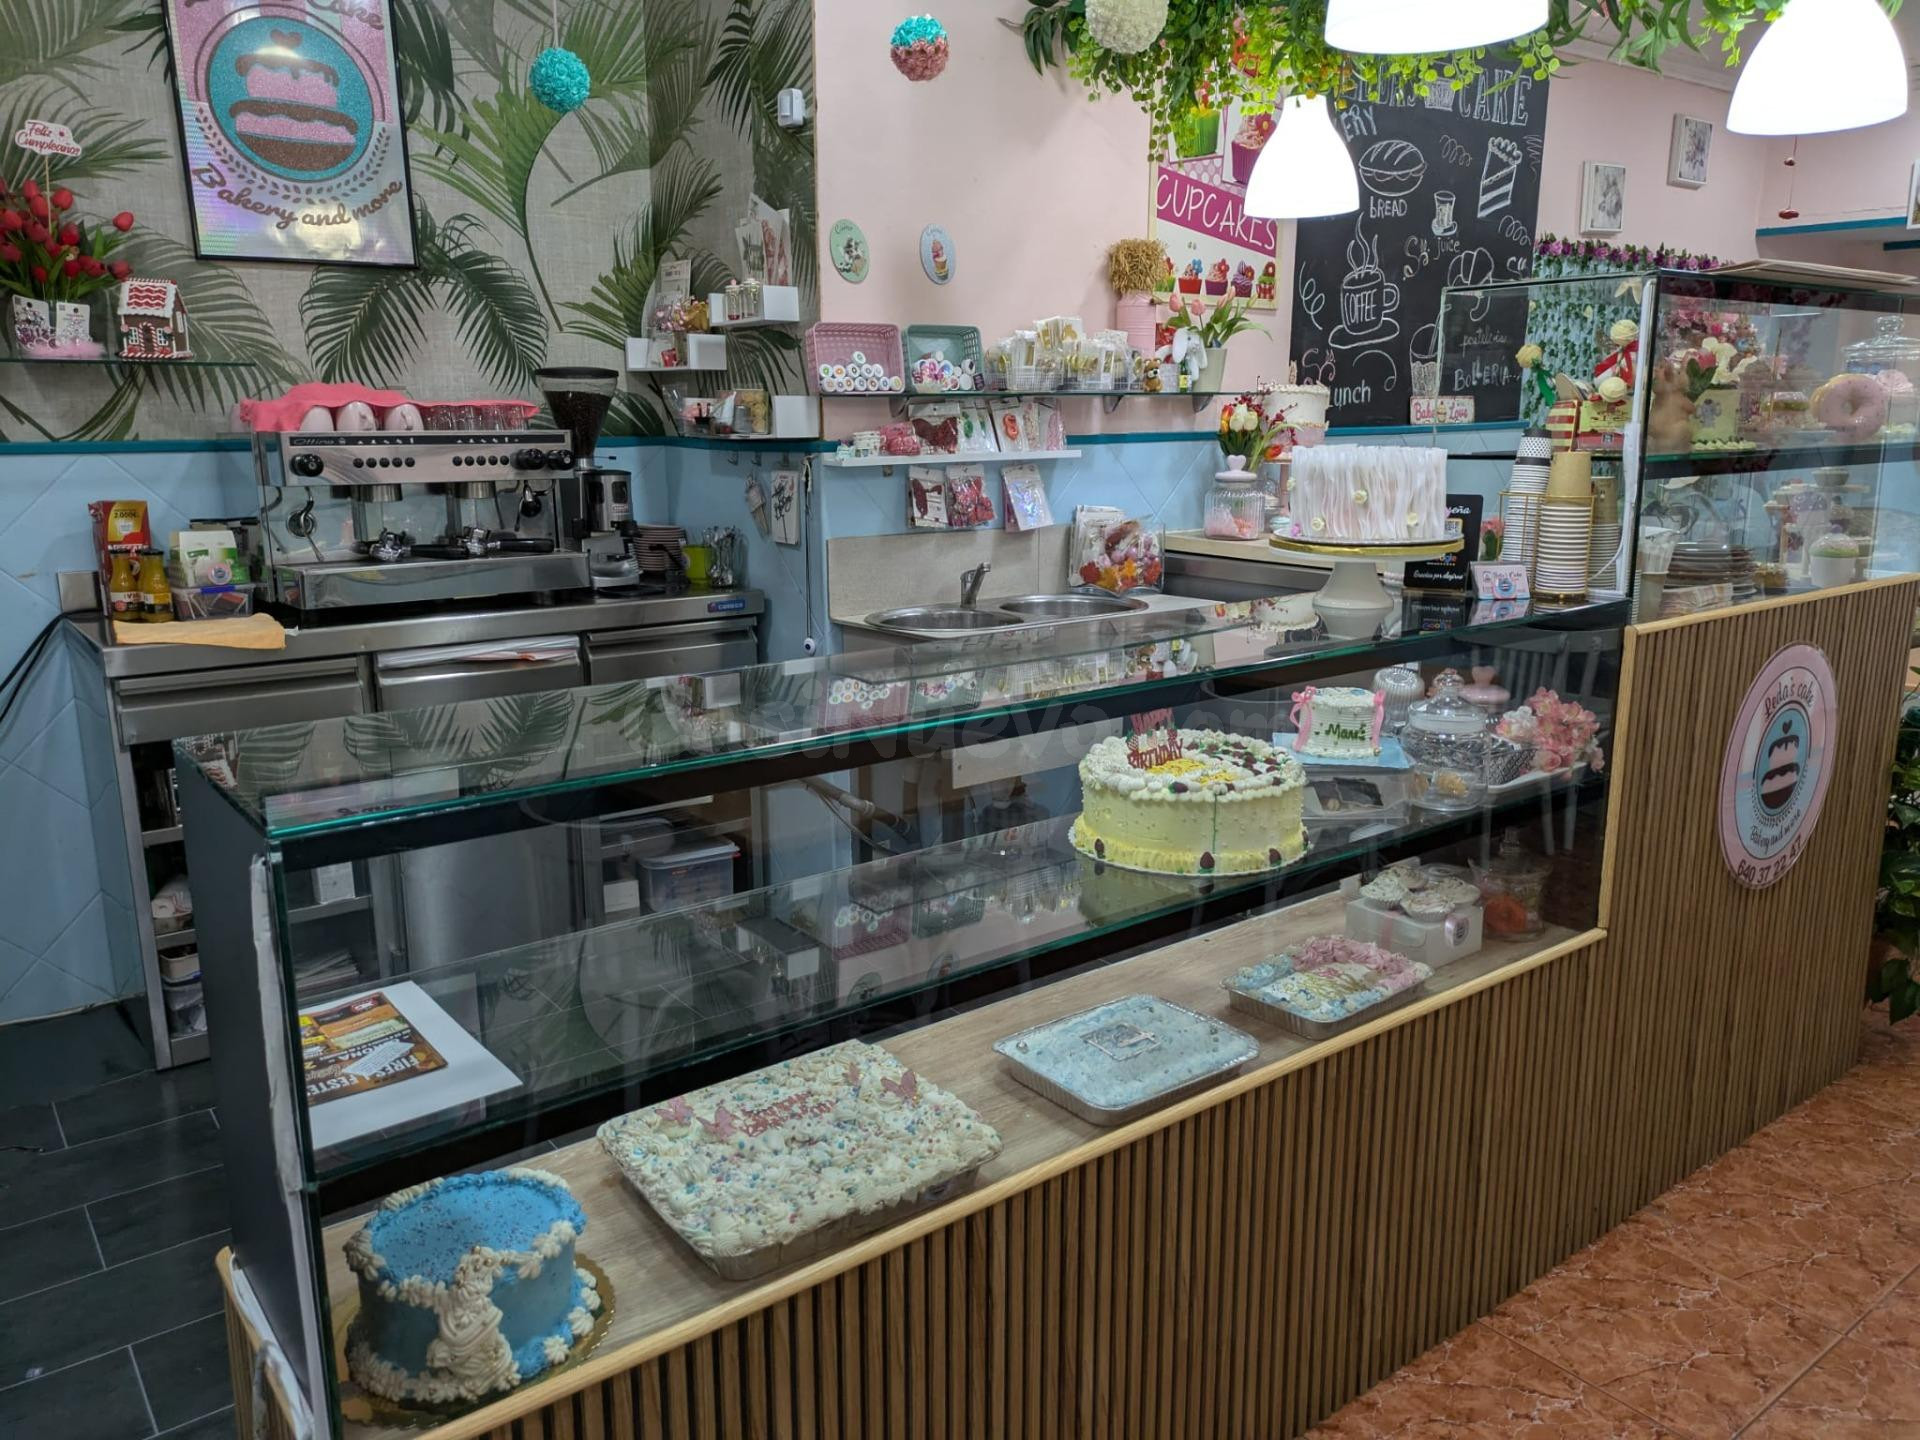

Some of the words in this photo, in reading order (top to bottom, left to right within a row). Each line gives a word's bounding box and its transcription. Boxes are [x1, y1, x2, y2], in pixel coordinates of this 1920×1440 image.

[1457, 67, 1532, 126] CAKE
[1340, 104, 1377, 142] ERY
[192, 162, 298, 229] Bakery
[301, 203, 351, 226] and
[352, 180, 403, 219] more
[1156, 174, 1275, 250] CUPCAKES
[1344, 288, 1377, 325] COFFEE
[1329, 379, 1371, 409] unch
[1127, 738, 1183, 769] BIRTHDAY
[1738, 859, 1756, 882] 640
[1757, 865, 1771, 883] 37
[1774, 854, 1786, 878] 22
[307, 1073, 359, 1096] FESTE
